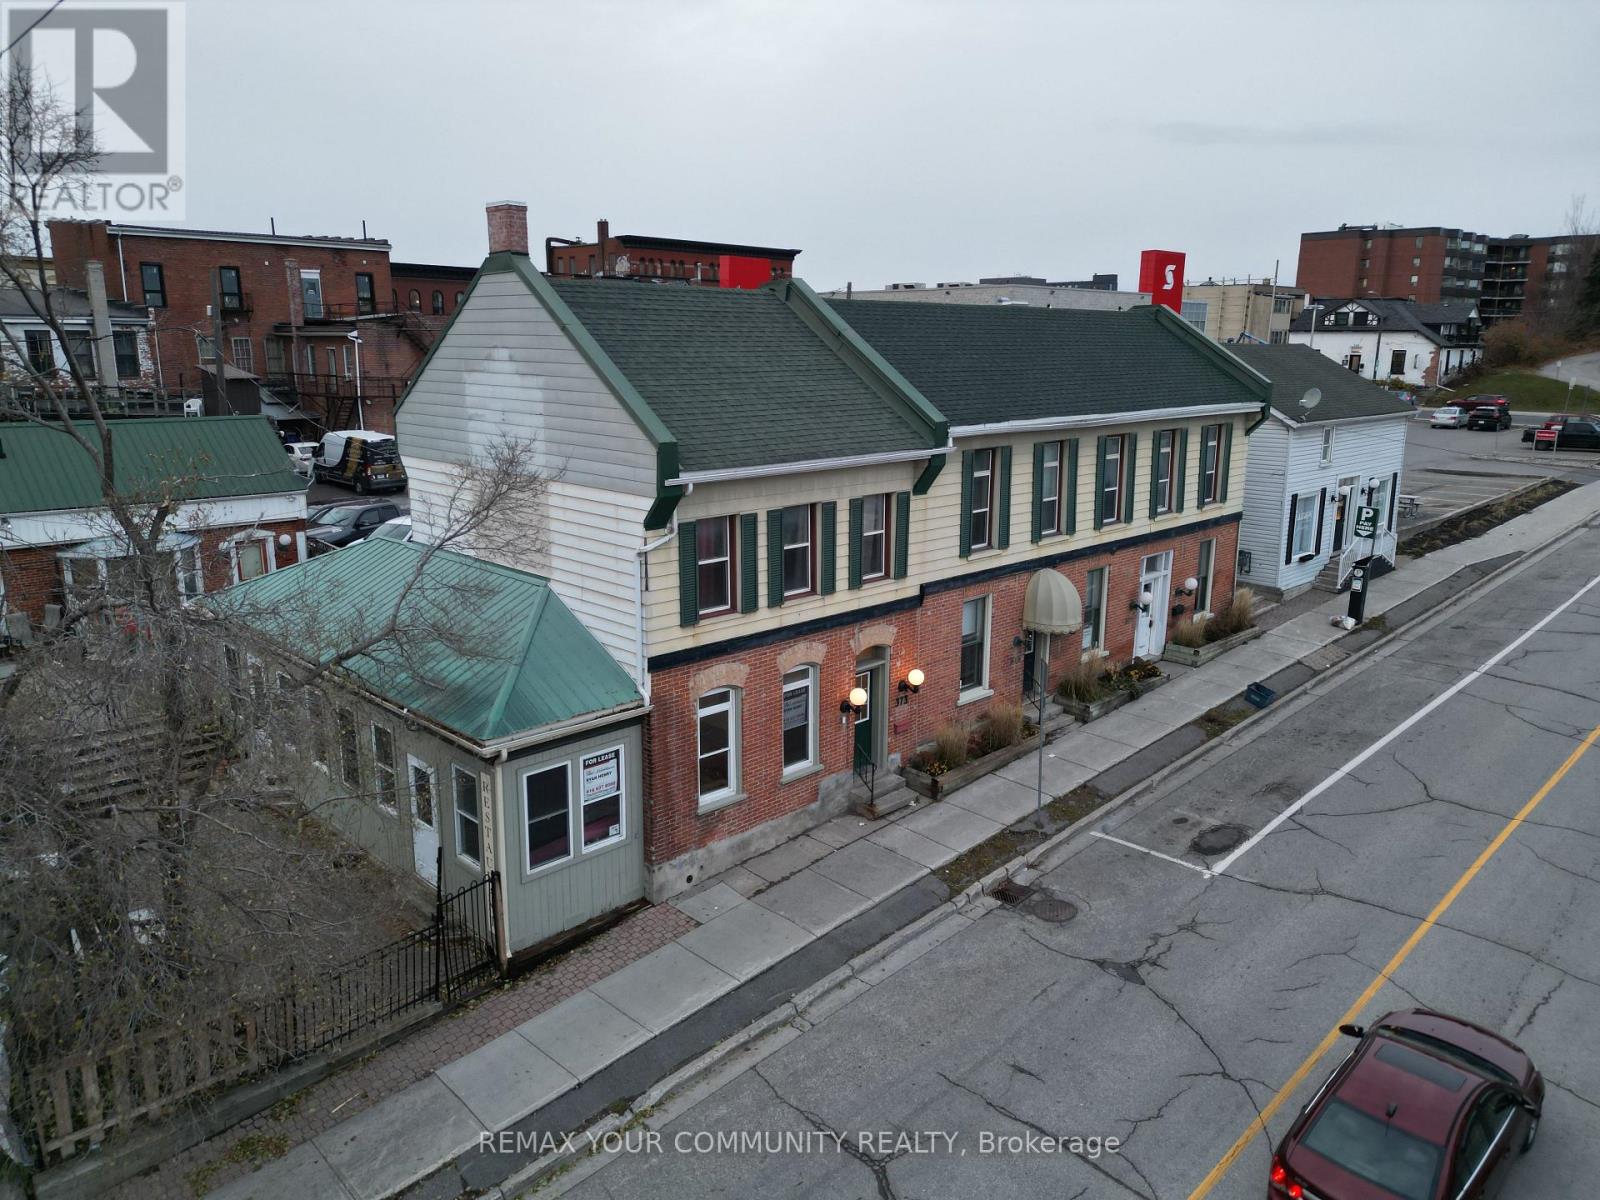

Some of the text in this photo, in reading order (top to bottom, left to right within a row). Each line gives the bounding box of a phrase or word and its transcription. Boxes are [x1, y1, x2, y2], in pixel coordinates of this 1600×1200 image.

[1361, 508, 1373, 520] P
[586, 752, 616, 766] FOR LEASE
